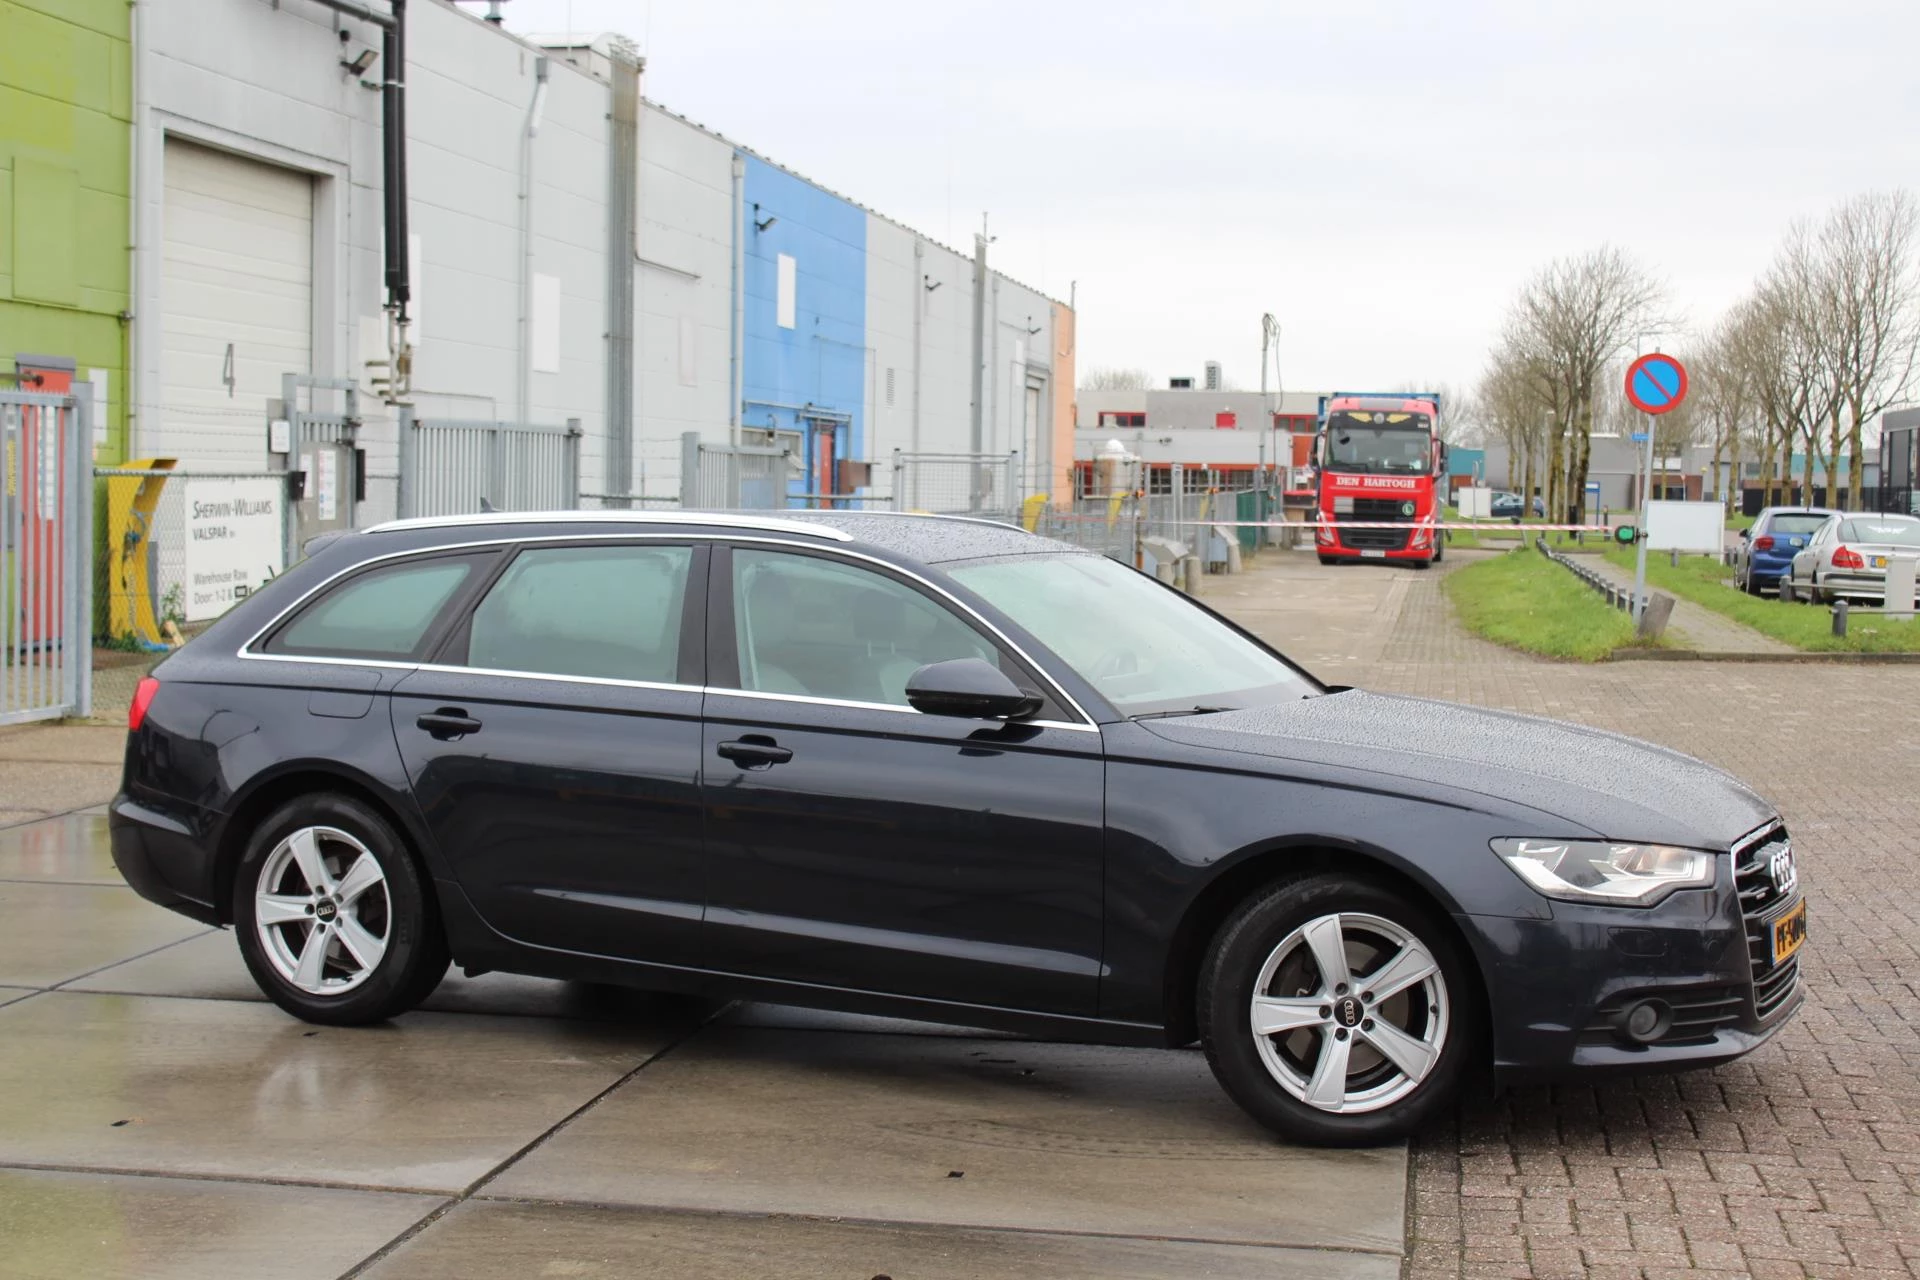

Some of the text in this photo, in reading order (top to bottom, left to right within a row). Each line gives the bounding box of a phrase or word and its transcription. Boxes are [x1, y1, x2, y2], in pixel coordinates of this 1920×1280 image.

[219, 343, 236, 382] 4
[1336, 476, 1415, 488] DEN HARTOGH
[193, 526, 227, 540] VALSPAR
[194, 572, 232, 585] Warehouse
